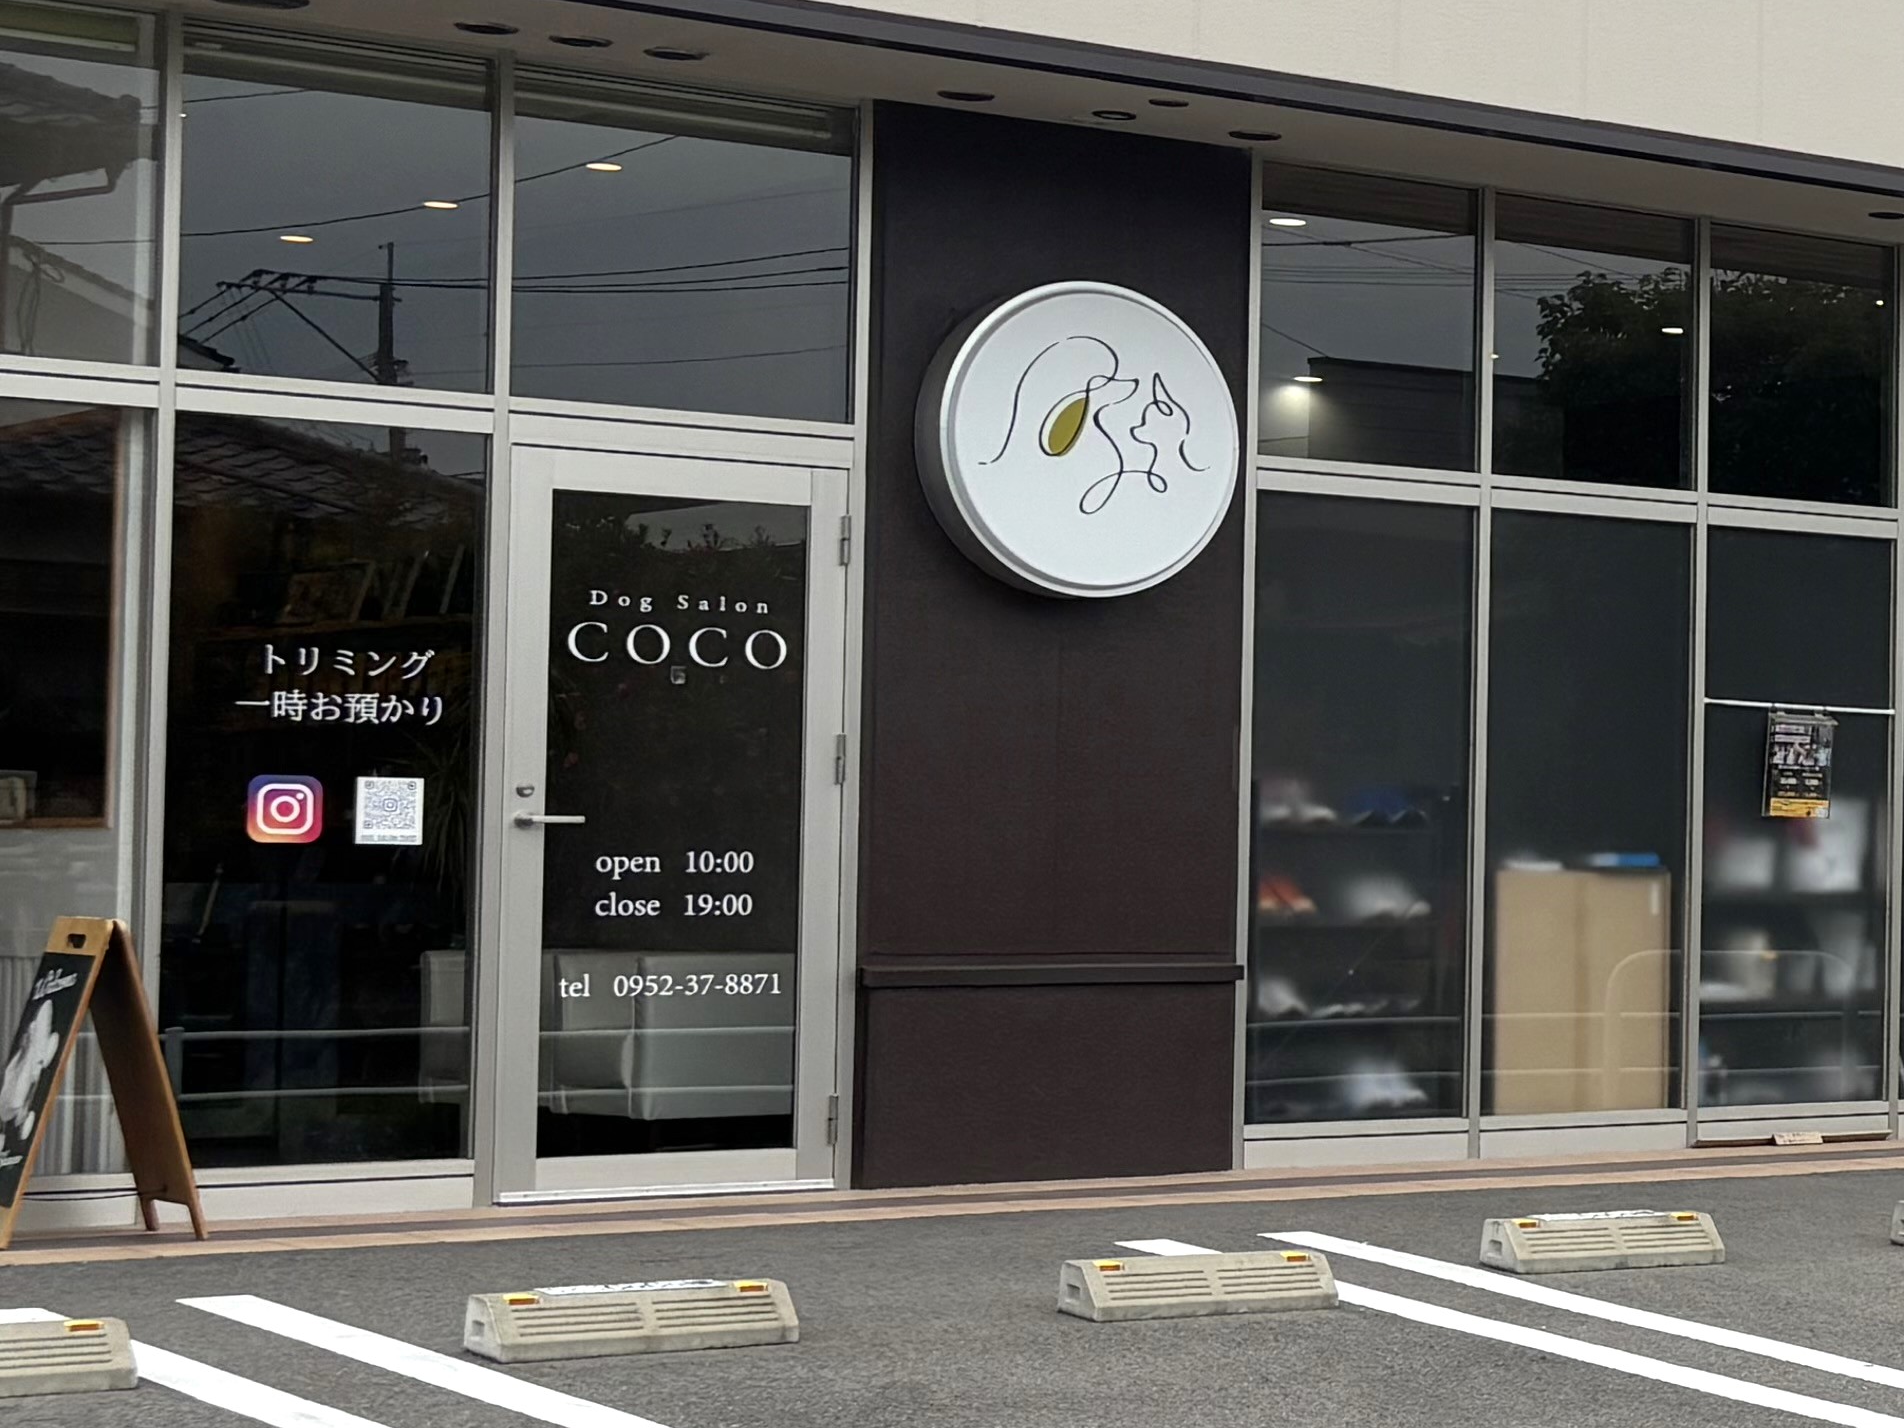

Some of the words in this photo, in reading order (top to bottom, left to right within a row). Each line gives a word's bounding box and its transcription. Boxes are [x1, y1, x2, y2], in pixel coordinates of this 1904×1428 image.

[589, 589, 654, 613] Dog
[677, 593, 771, 614] Salon
[567, 621, 787, 670] COCO
[261, 645, 435, 679] トリミング
[235, 691, 445, 727] 一時お預かり
[595, 851, 661, 877] open
[685, 850, 754, 875] 10:00
[595, 893, 661, 918] close
[683, 893, 753, 917] 19:00
[559, 975, 591, 999] tel
[613, 972, 782, 998] 0952-37-8871
